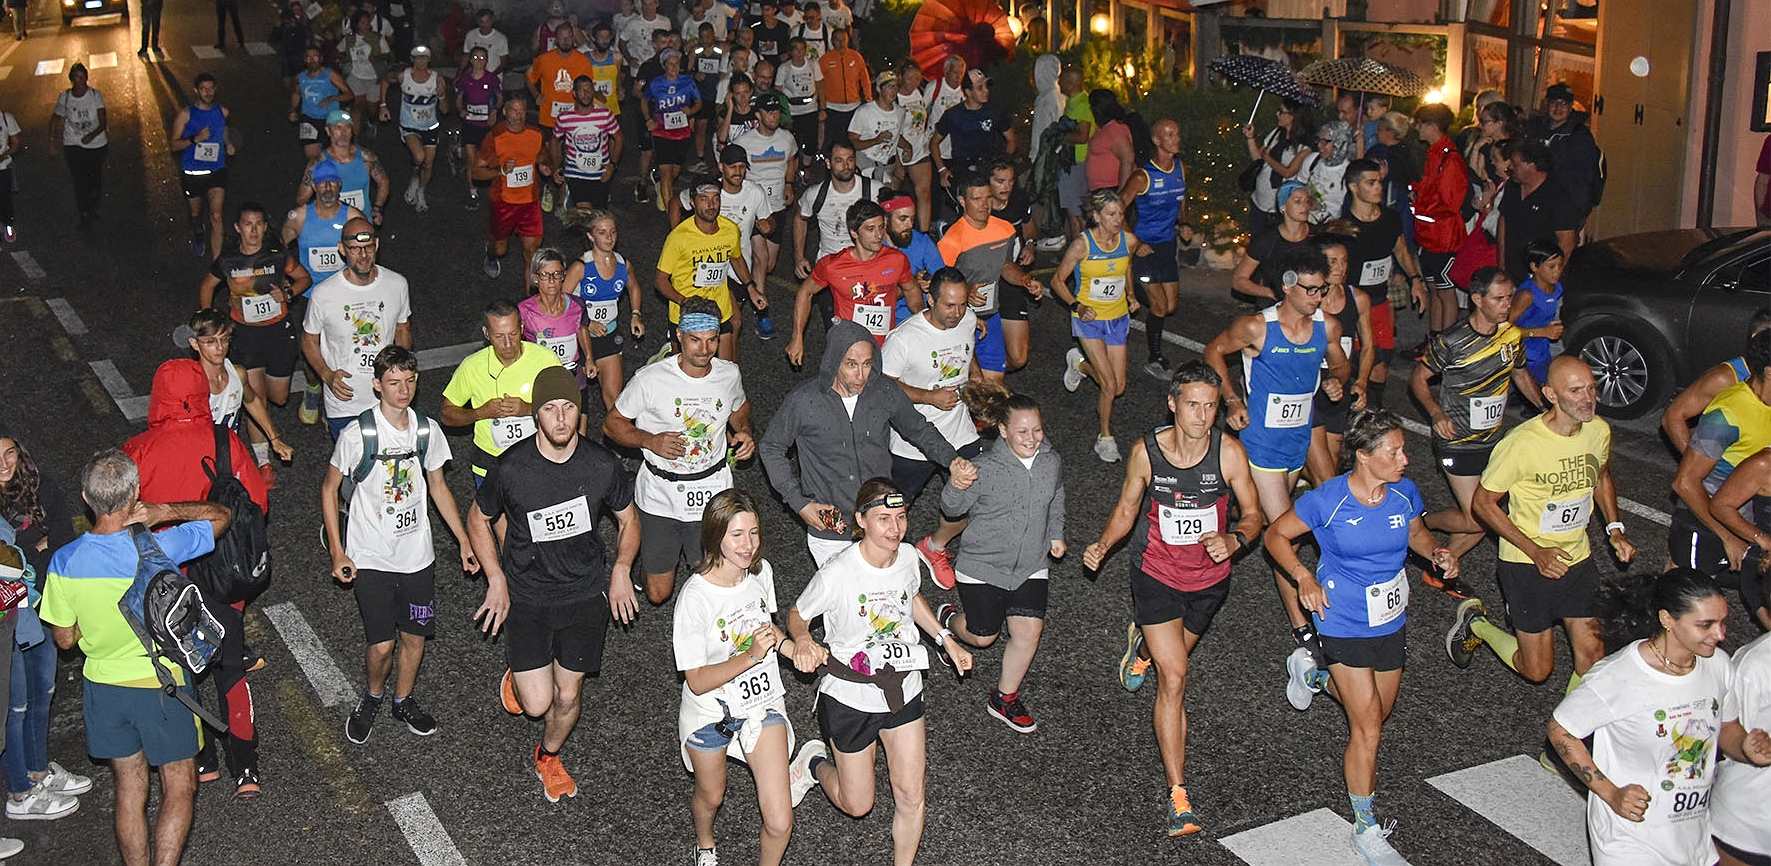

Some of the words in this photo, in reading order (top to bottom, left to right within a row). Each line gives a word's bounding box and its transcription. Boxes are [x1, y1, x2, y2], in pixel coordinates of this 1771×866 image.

[659, 94, 686, 110] RUN
[671, 115, 682, 125] 414
[583, 157, 597, 167] 768
[515, 171, 529, 182] 139
[319, 253, 336, 265] 130
[706, 269, 724, 281] 301
[1102, 284, 1116, 297] 42
[254, 301, 272, 315] 131
[594, 307, 608, 320] 88
[865, 313, 884, 328] 142
[1281, 403, 1303, 419] 671
[1484, 403, 1503, 420] 102
[506, 423, 523, 439] 35
[1558, 454, 1585, 471] THE
[1535, 467, 1585, 485] NORTH
[1551, 478, 1585, 496] FACE
[395, 508, 417, 530] 364
[545, 511, 576, 532] 552
[1561, 506, 1580, 524] 67
[1174, 518, 1203, 536] 129
[1386, 587, 1401, 610] 66
[881, 642, 911, 660] 361
[739, 671, 771, 700] 363
[1673, 788, 1710, 814] 804
